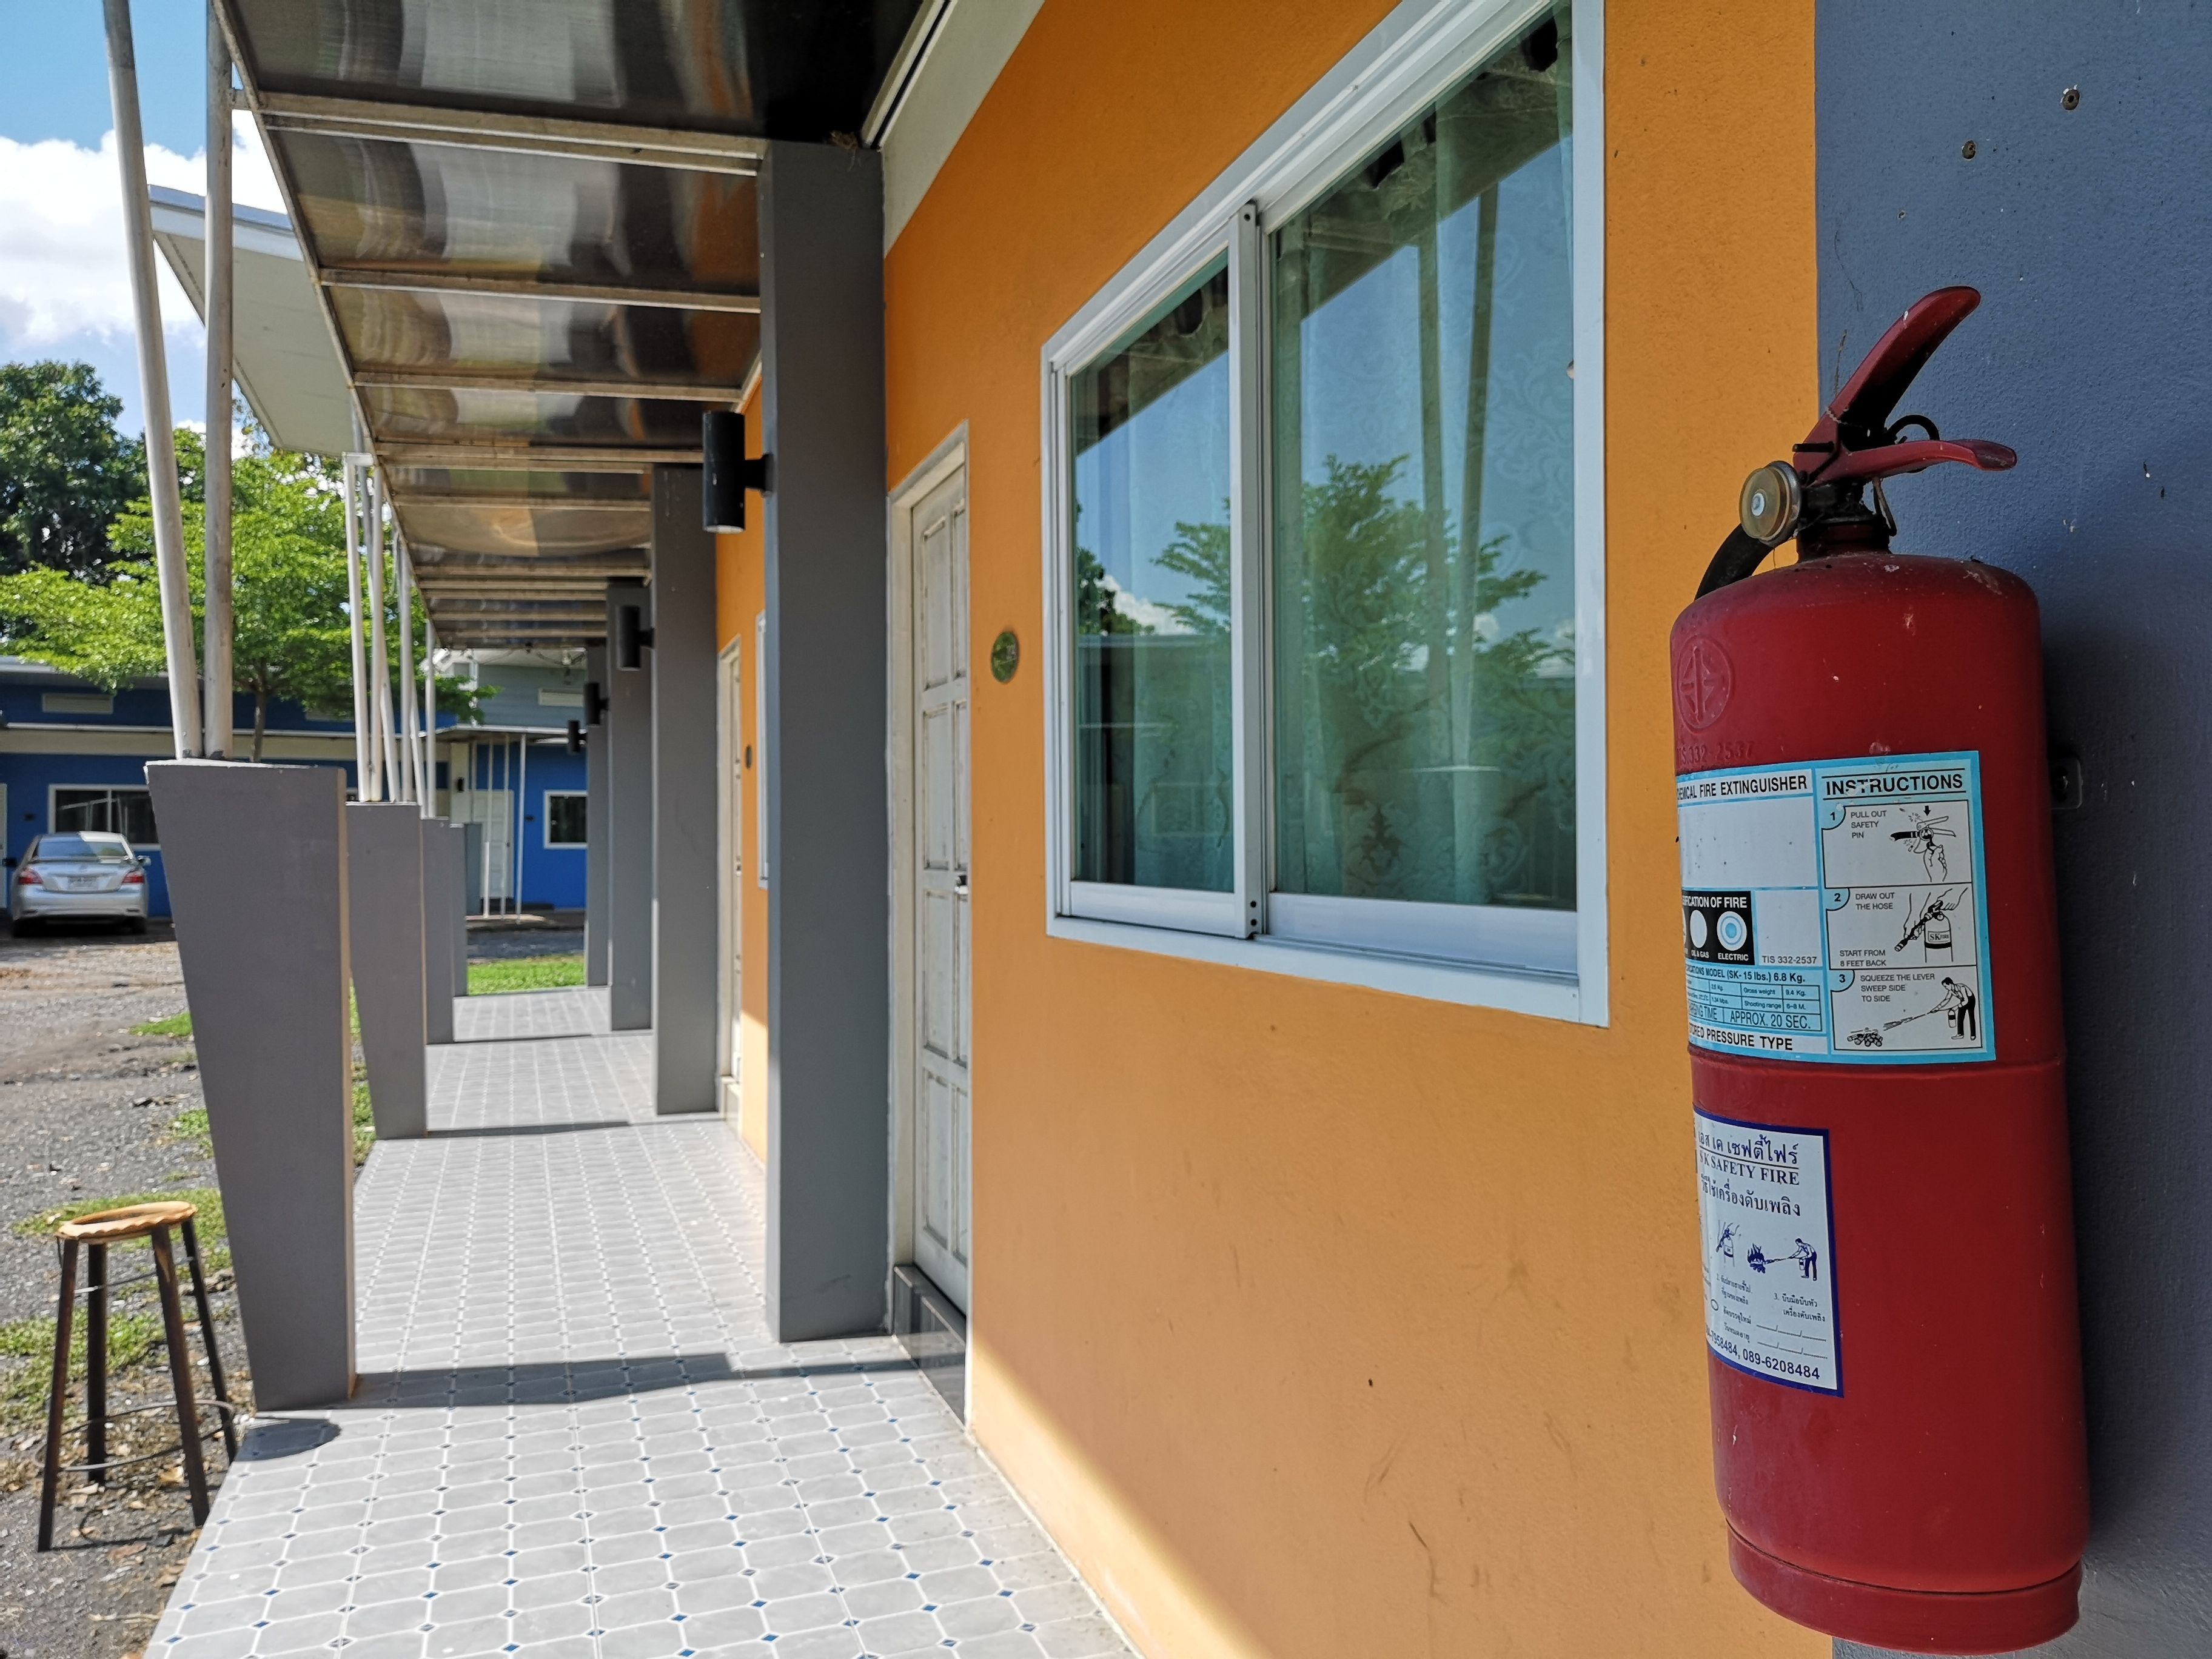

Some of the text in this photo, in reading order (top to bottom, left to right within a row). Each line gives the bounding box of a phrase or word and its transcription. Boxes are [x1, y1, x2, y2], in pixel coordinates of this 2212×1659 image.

[1700, 782, 1717, 799] FIRE
[1720, 774, 1808, 796] EXTINGUISHER
[1826, 773, 1963, 796] INSTRUCTIONS
[1829, 811, 1836, 821] 1
[1851, 820, 1880, 829] SAFETY
[1710, 896, 1723, 908] OF
[1724, 897, 1748, 909] FIRE
[1834, 893, 1841, 902] 2
[1718, 952, 1749, 962] ELECTRIC
[1761, 955, 1817, 965] TIS 332-2537
[1705, 967, 1726, 979] MODEL
[1754, 971, 1772, 982] lbs.)
[1774, 973, 1787, 982] 6.8
[1789, 973, 1806, 984] Kg.
[1839, 974, 1846, 983] 3
[1744, 1000, 1766, 1009] Shooting
[1704, 1006, 1718, 1021] TIME
[1730, 1010, 1769, 1027] APPROX.
[1771, 1013, 1782, 1027] 20
[1785, 1015, 1811, 1029] SEC.
[1707, 1028, 1755, 1047] PRESSURE
[1760, 1036, 1794, 1051] TYPE
[1711, 1153, 1756, 1179] SAFETY
[1760, 1167, 1800, 1185] FIRE
[1774, 1292, 1780, 1301] 3.
[1743, 1348, 1821, 1380] 089-6208484
